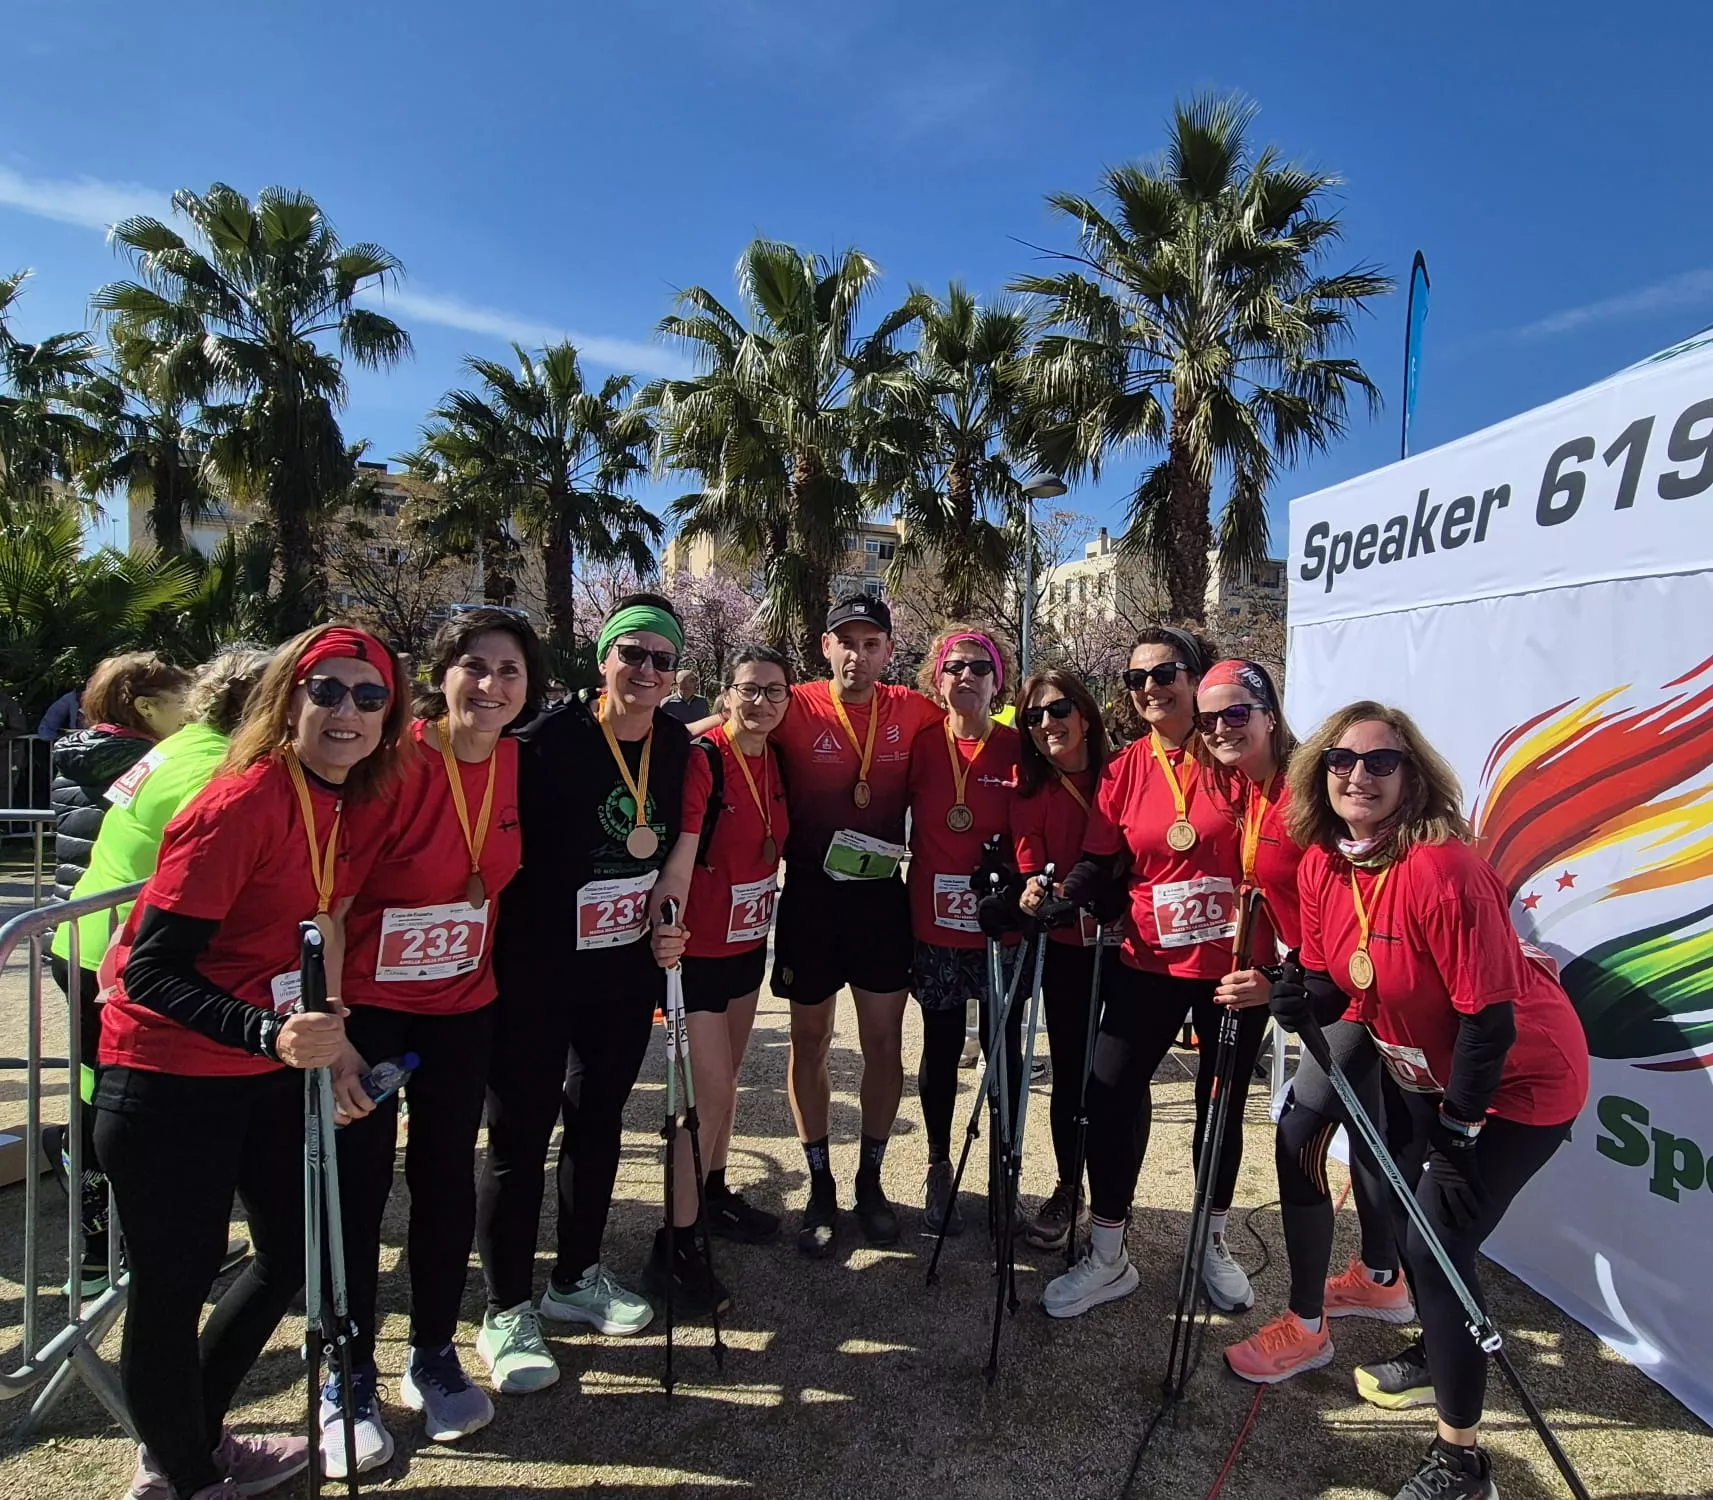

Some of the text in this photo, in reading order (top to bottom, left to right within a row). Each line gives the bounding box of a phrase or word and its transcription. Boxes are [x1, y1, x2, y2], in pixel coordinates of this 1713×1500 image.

[1300, 398, 1713, 594] Speaker 619
[858, 854, 872, 874] 1
[946, 892, 978, 915] 23
[1168, 895, 1223, 928] 226
[402, 925, 469, 959] 232
[667, 1008, 675, 1046] LEKI
[678, 1006, 687, 1043] LEKI
[1596, 1095, 1713, 1204] Sp
